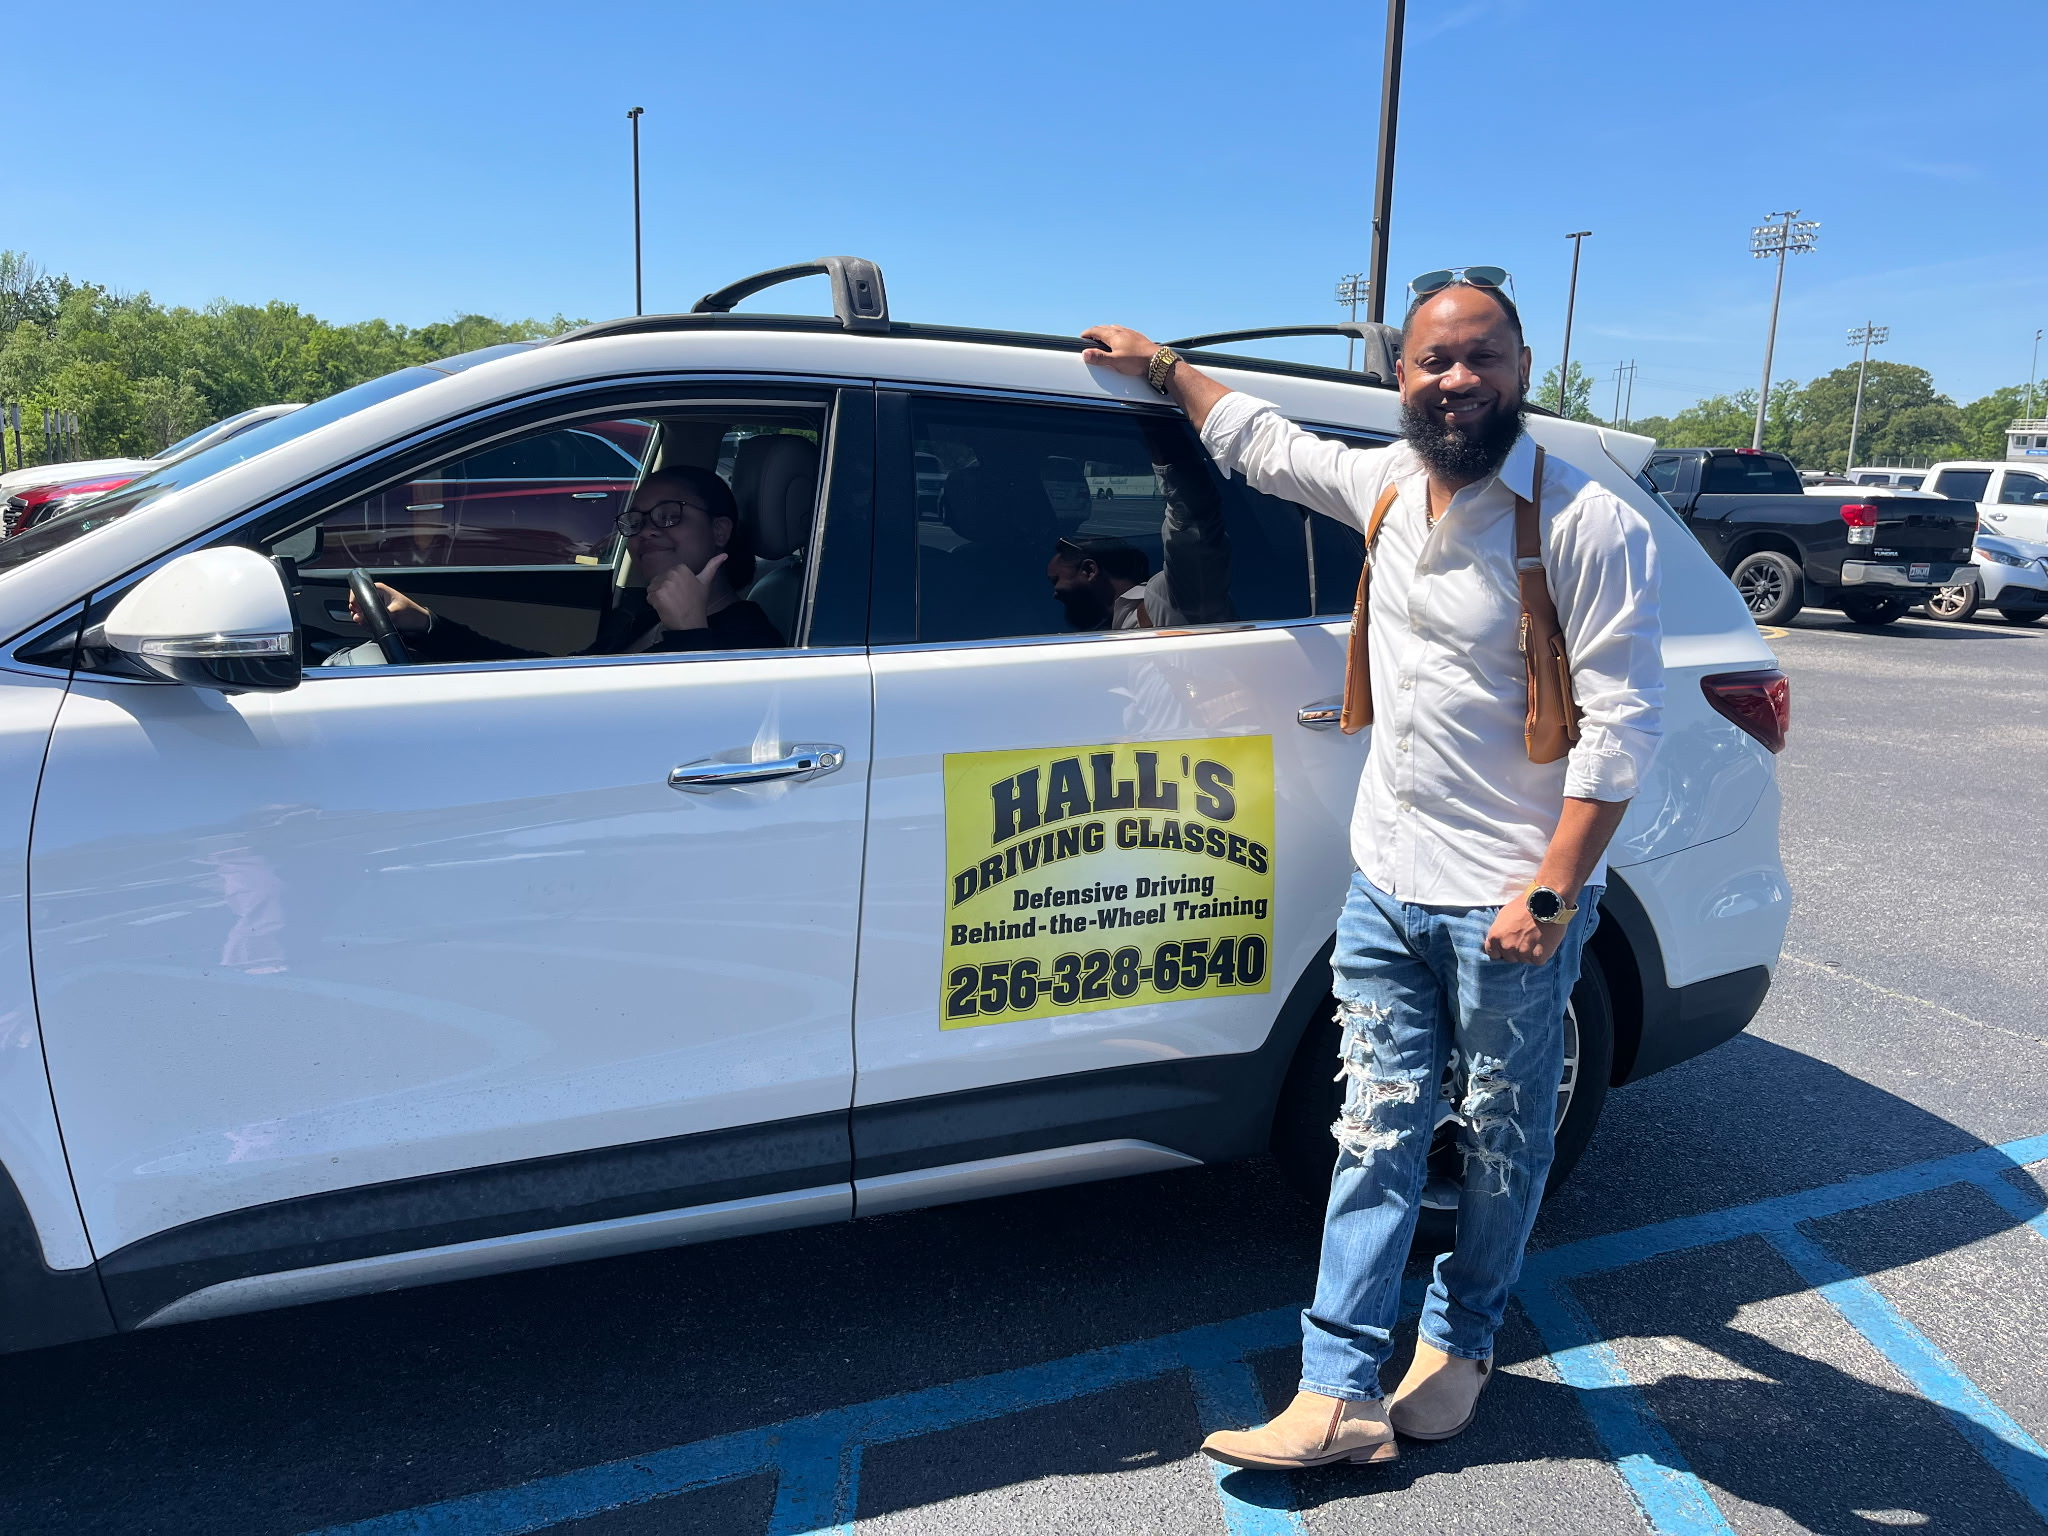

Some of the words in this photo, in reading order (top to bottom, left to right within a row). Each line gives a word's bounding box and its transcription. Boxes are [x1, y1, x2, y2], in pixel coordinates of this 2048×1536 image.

[991, 750, 1237, 848] HALL'S
[952, 821, 1105, 909] DRIVING
[1116, 817, 1269, 875] CLASSES
[1013, 882, 1128, 911] Defensive
[1136, 873, 1215, 899] Driving
[951, 903, 1166, 946] Behind-the-Wheel
[1173, 895, 1268, 922] Training
[946, 934, 1267, 1020] 256-328-6540
